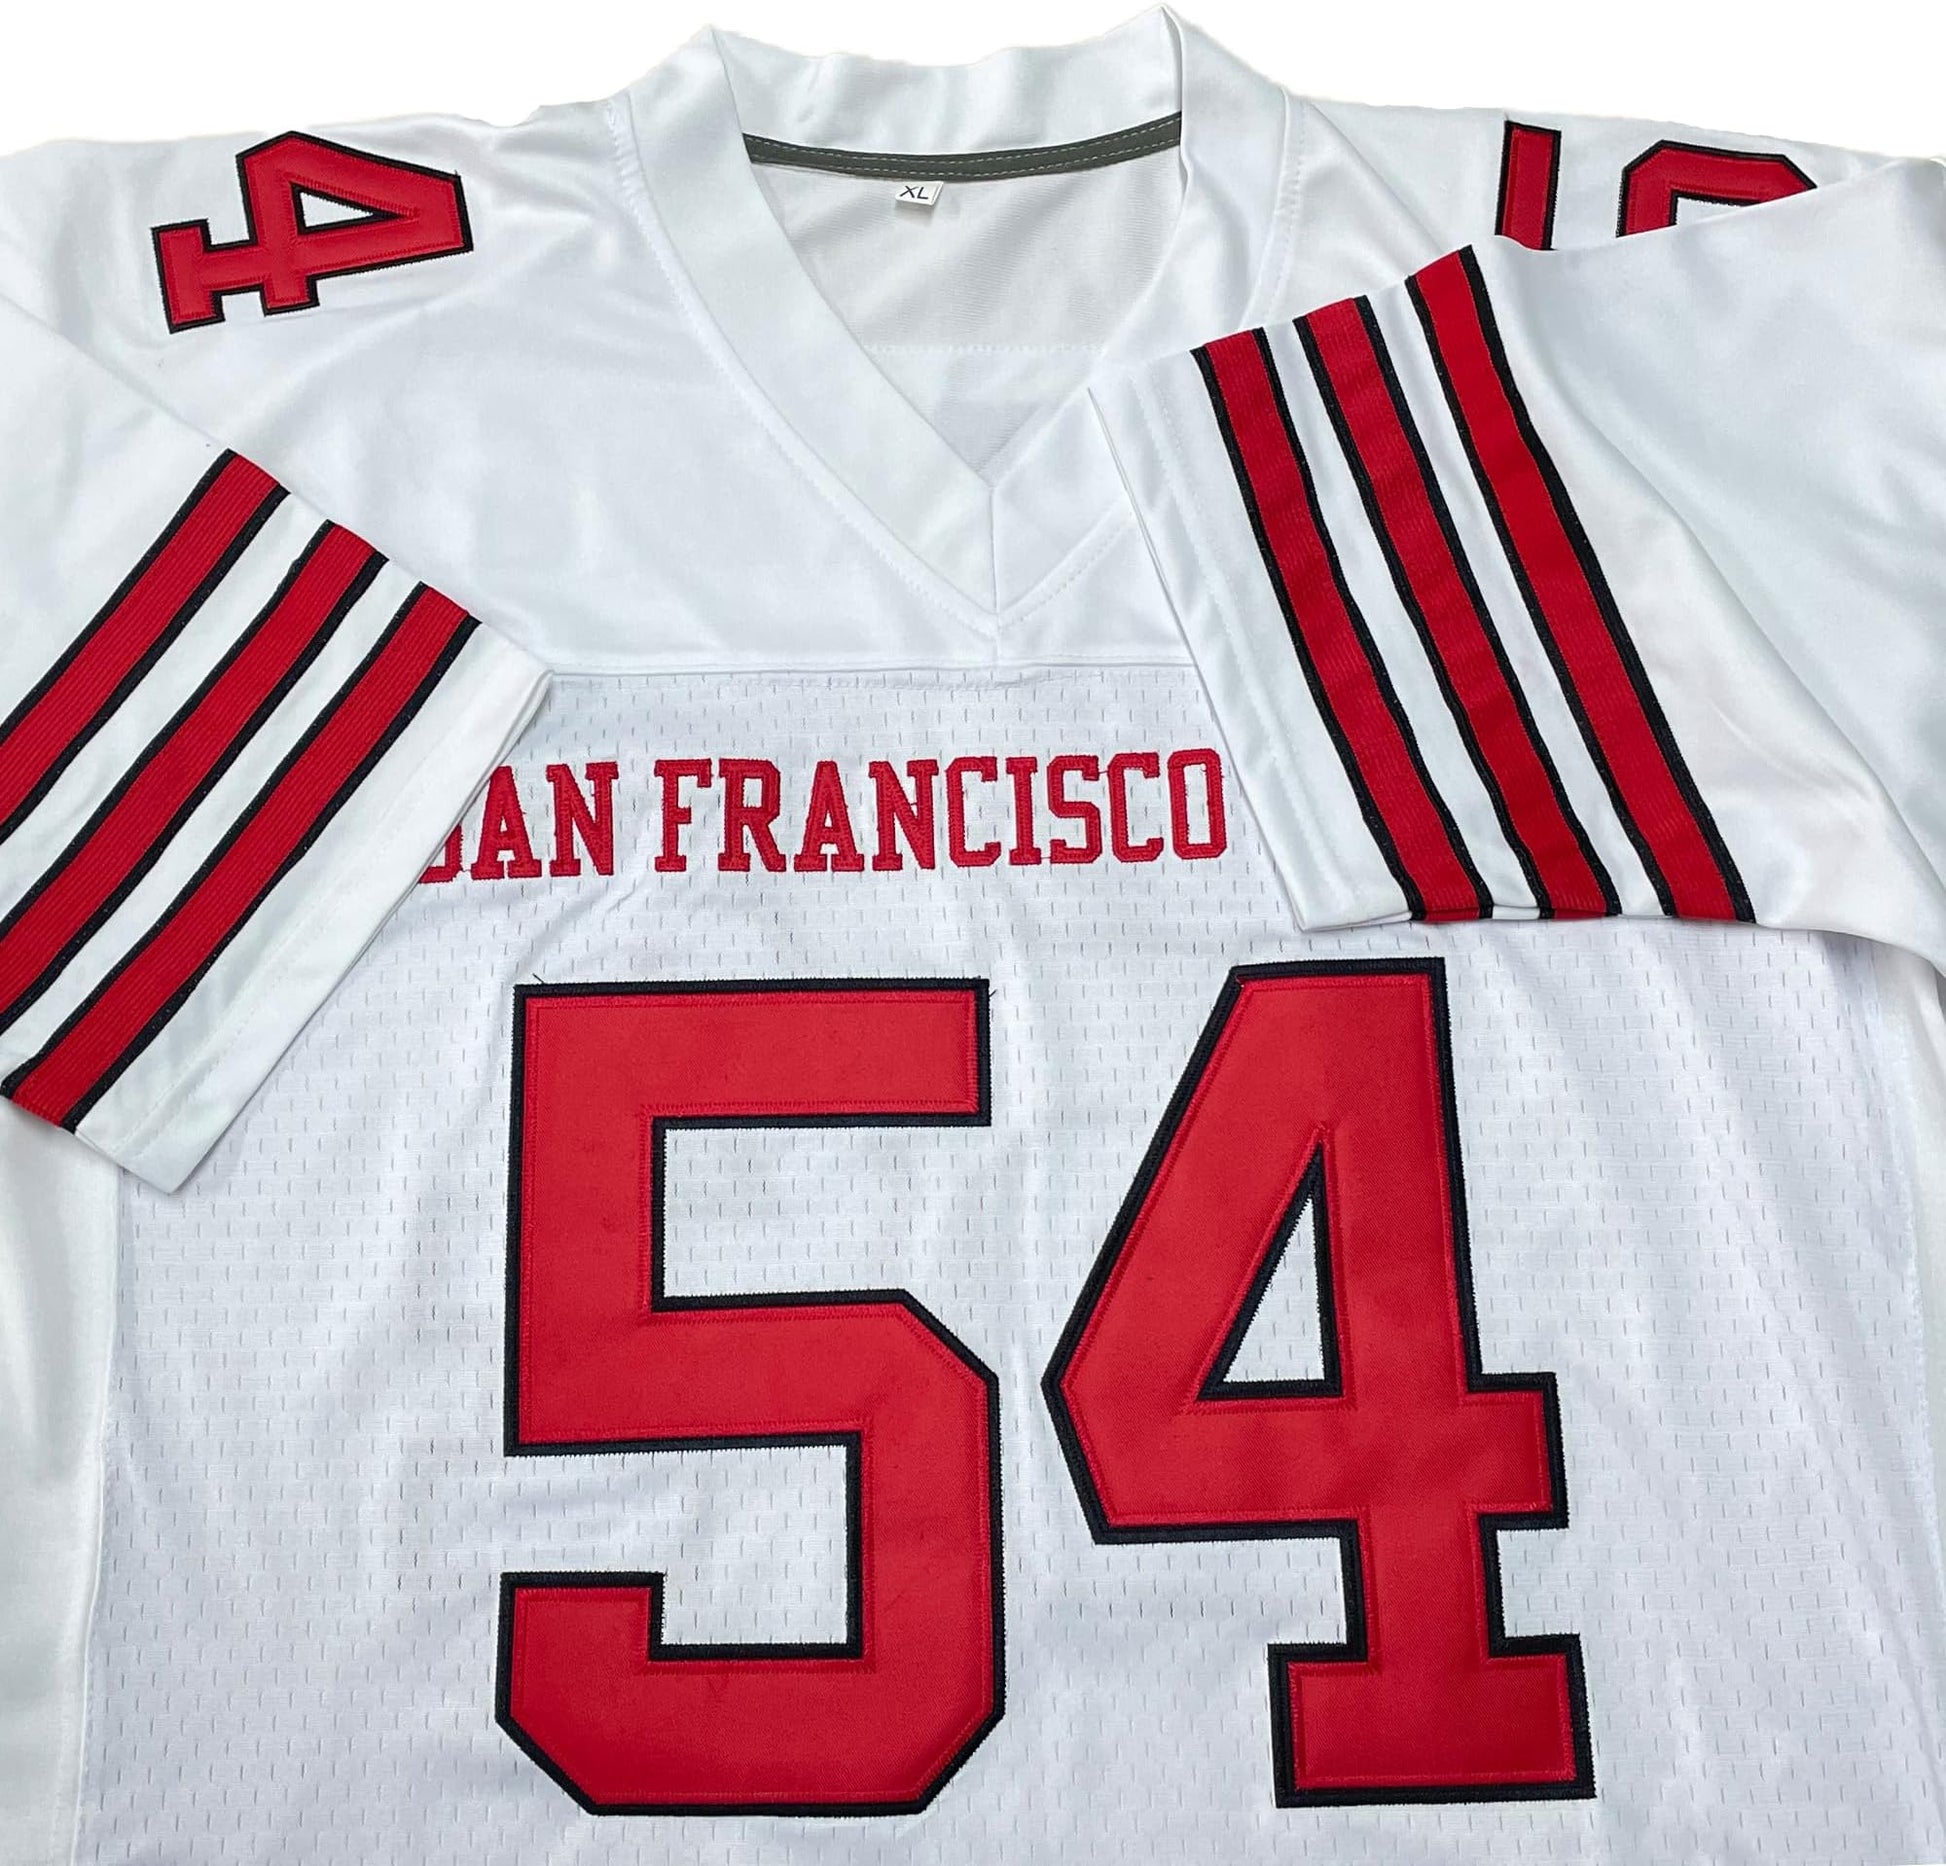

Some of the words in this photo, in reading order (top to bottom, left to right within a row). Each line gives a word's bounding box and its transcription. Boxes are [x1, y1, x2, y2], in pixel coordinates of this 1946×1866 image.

[151, 130, 474, 335] 4
[899, 185, 929, 200] XL
[654, 747, 1228, 873] FRANCISCO
[495, 957, 1597, 1818] 54
